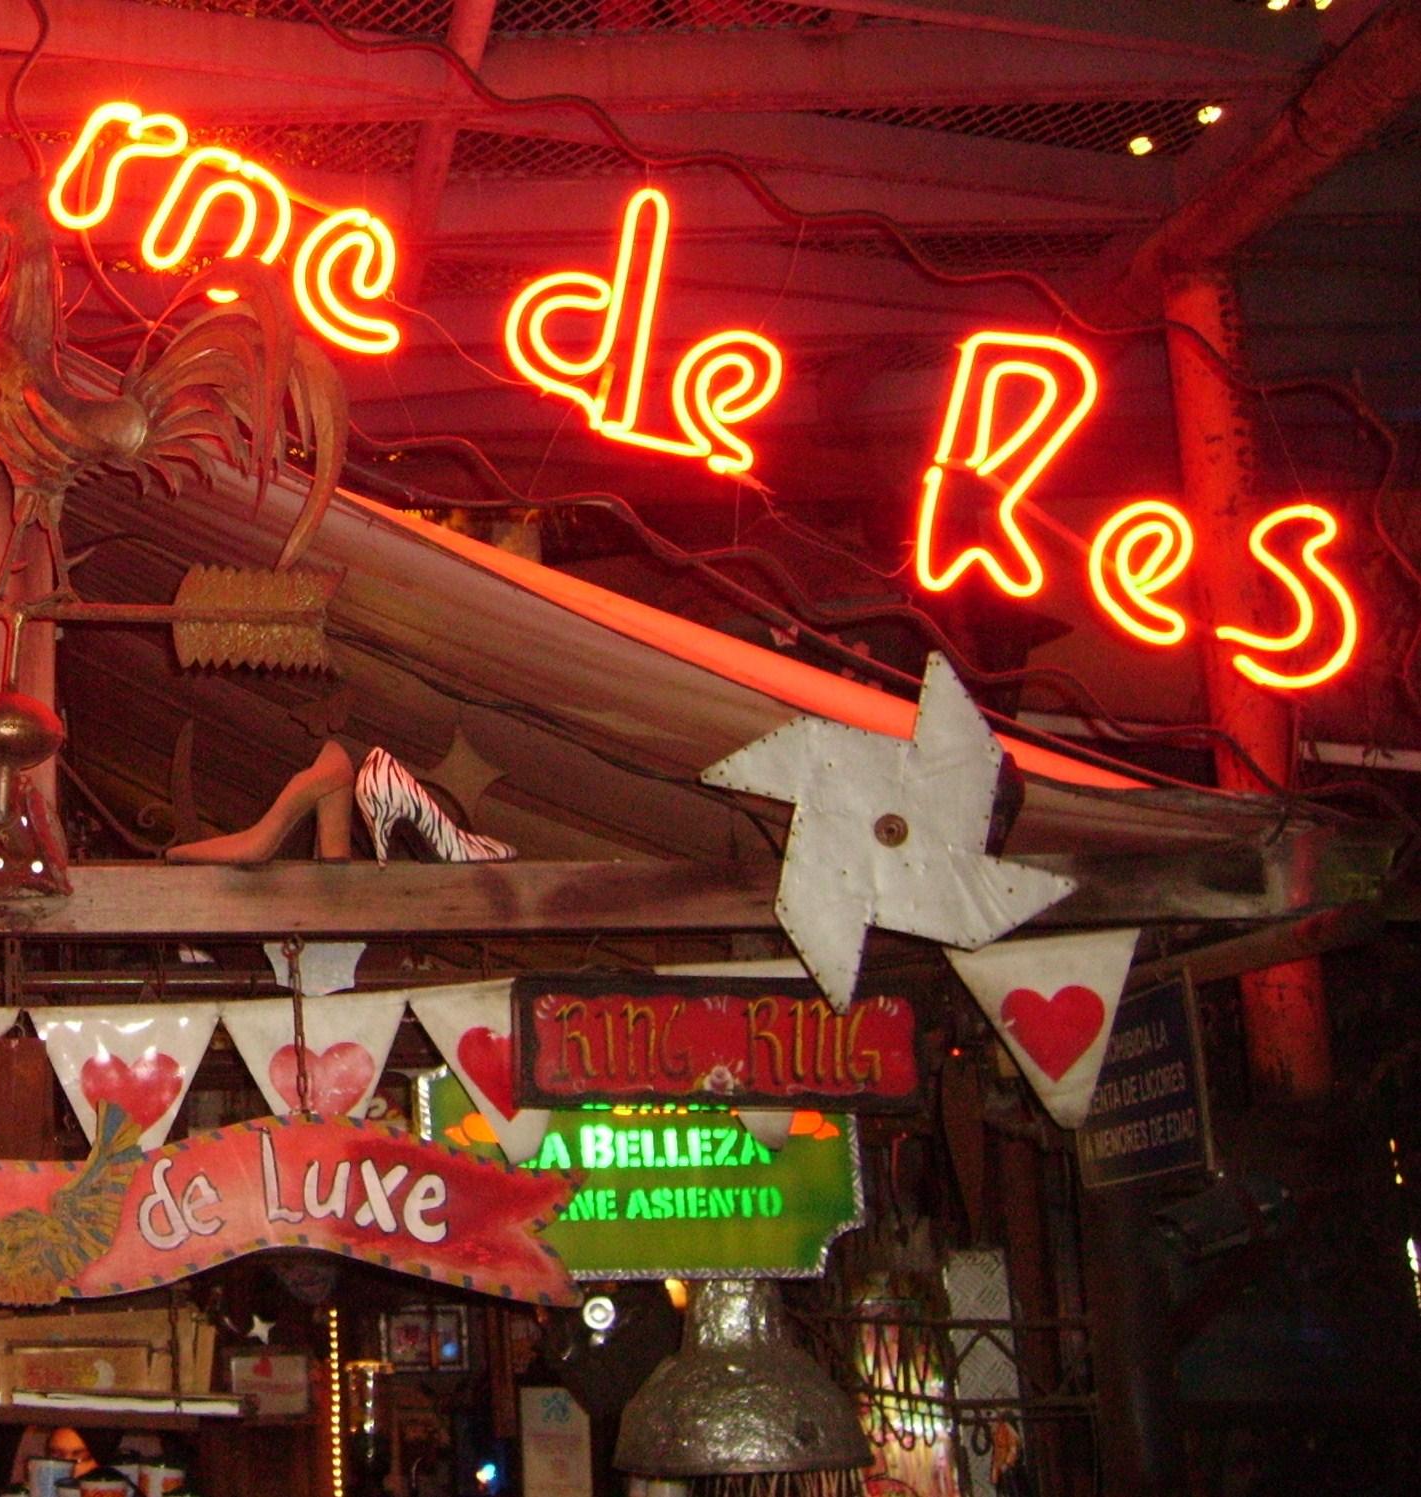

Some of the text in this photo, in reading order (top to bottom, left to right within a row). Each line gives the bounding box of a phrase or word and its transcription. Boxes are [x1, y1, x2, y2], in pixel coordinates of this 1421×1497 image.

[505, 187, 783, 473] de
[916, 331, 1357, 688] Res
[136, 1157, 223, 1250] de
[260, 1126, 450, 1244] Luxe
[579, 1123, 772, 1170] BELLEZA
[626, 1186, 785, 1221] ASIENTO
